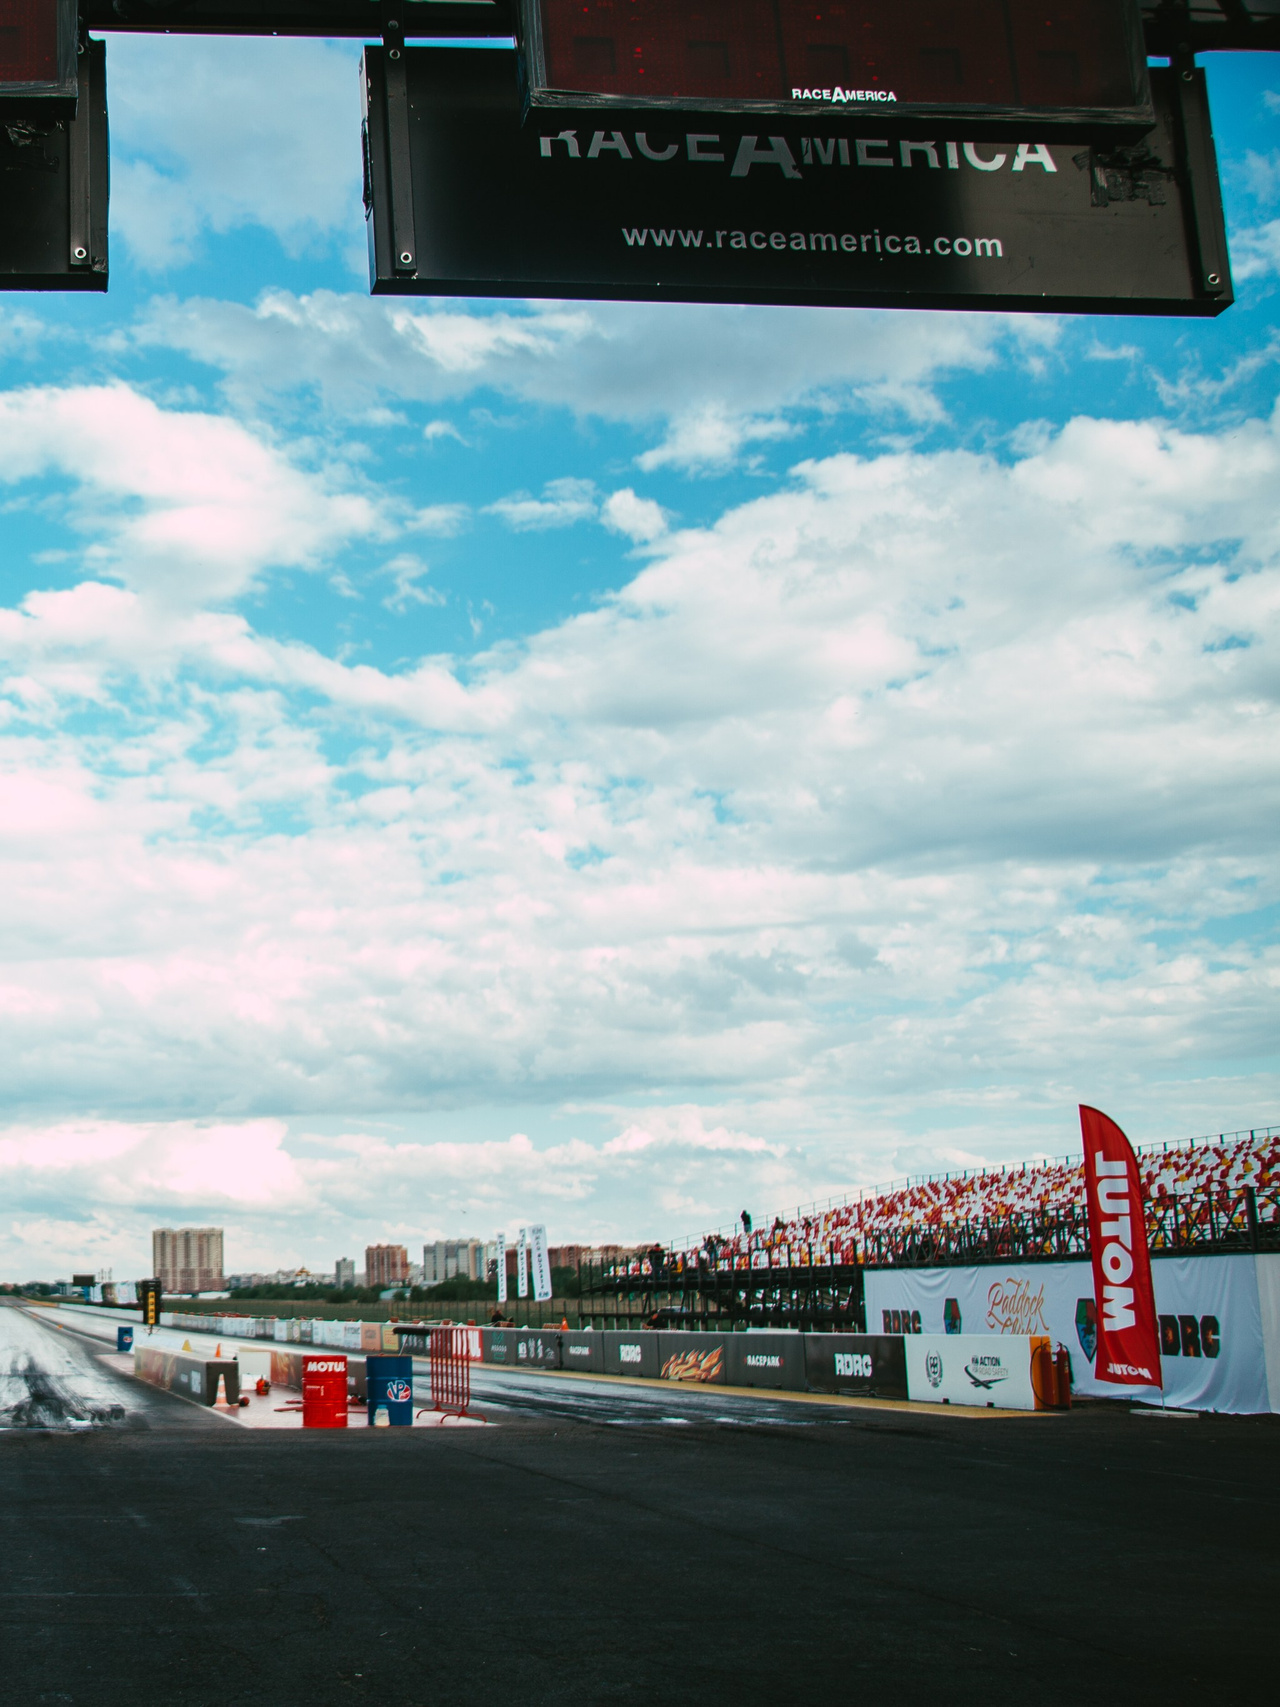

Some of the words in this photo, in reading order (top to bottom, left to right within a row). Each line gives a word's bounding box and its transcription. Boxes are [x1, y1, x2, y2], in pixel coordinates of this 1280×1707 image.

[791, 86, 897, 103] RACEAMERICA
[621, 228, 1004, 258] www.raceamerica.com
[985, 1277, 1050, 1331] Paddock
[1157, 1314, 1221, 1358] DRC
[307, 1361, 346, 1373] MOTUL
[747, 1355, 780, 1367] RACEPARK
[834, 1353, 872, 1377] RDRC
[980, 1356, 1001, 1367] ACTION
